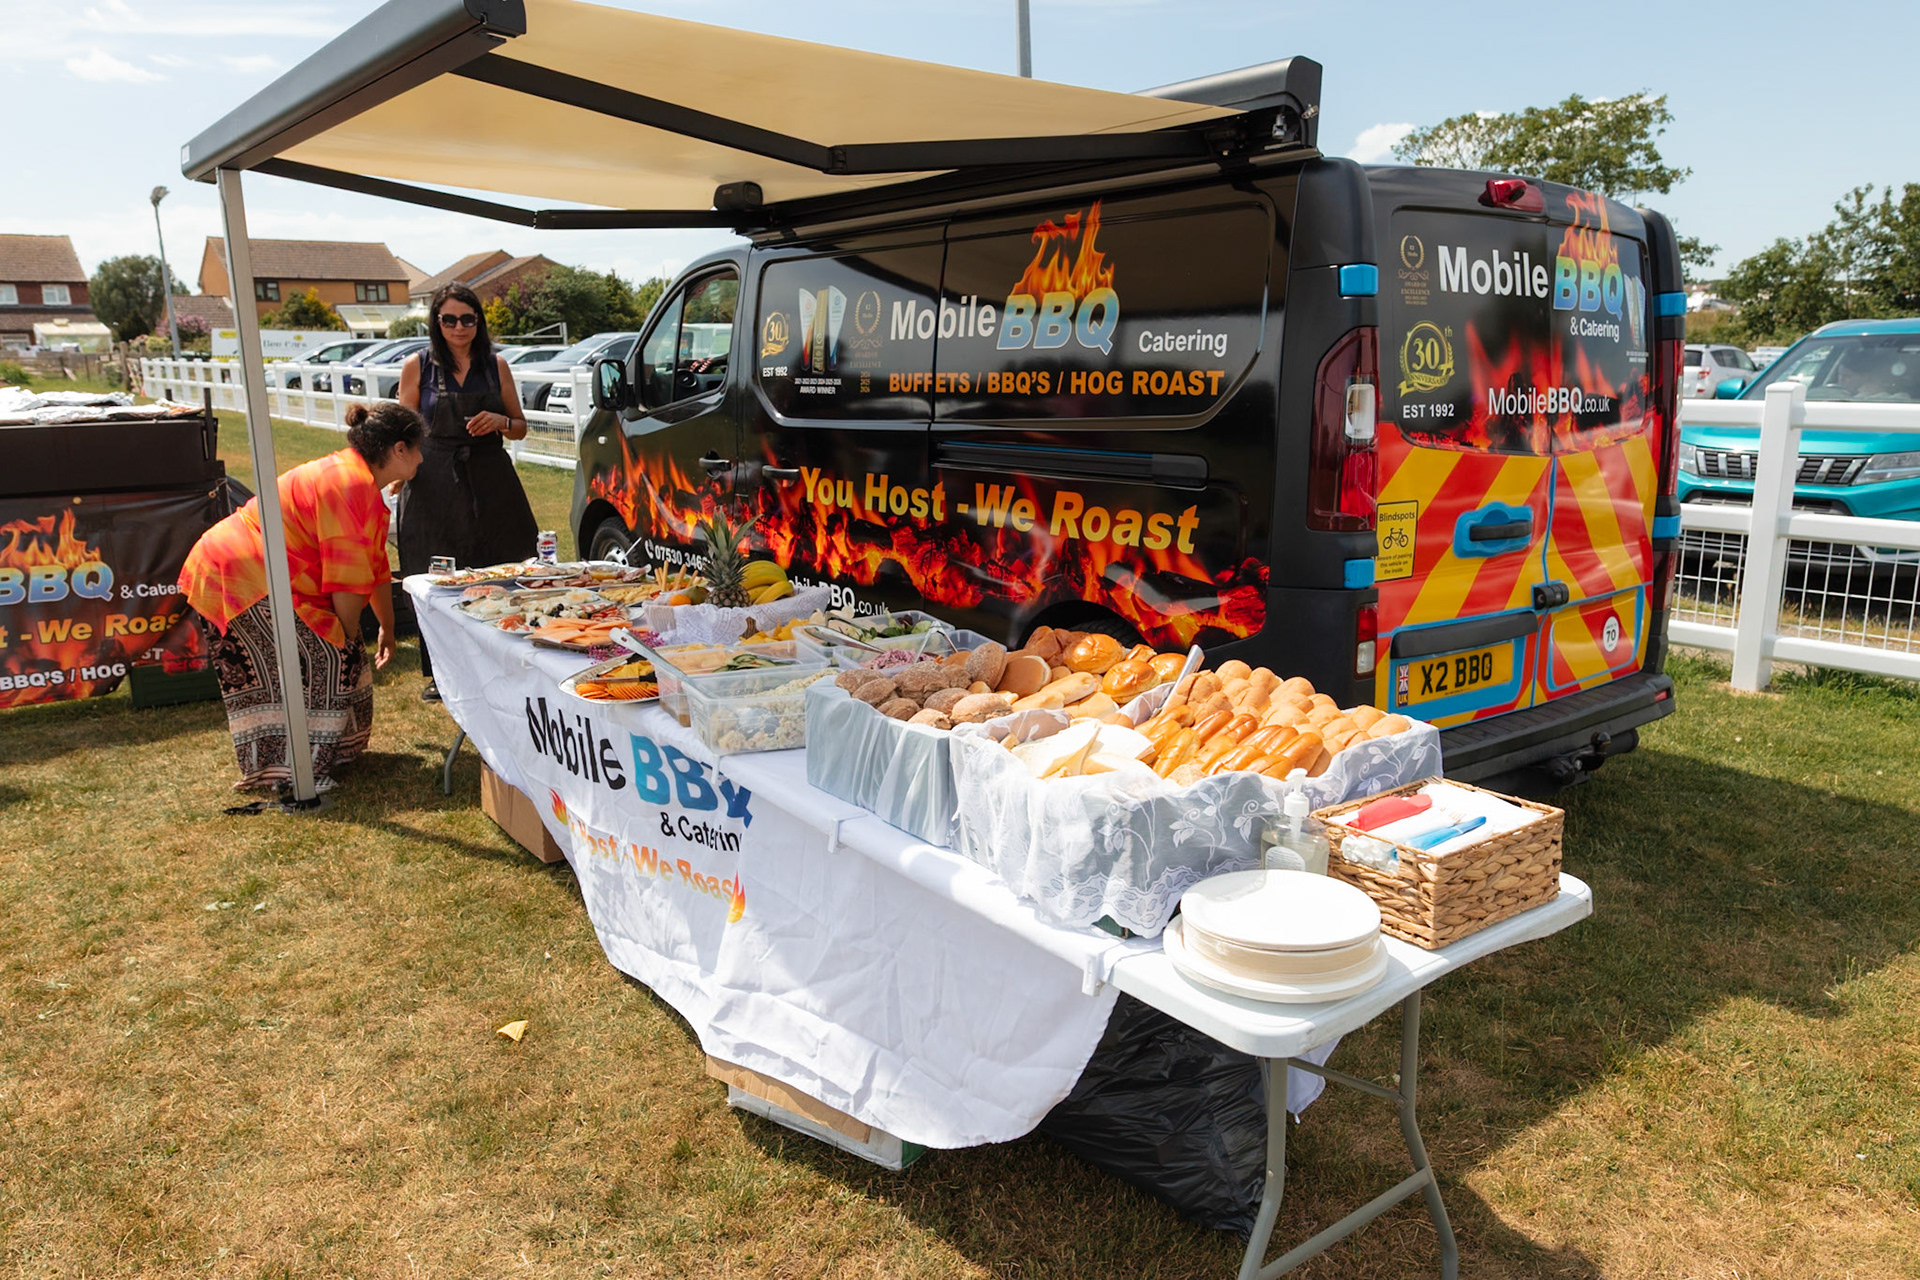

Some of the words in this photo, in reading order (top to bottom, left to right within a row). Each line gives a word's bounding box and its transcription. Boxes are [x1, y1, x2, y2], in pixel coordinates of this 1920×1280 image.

[1438, 245, 1549, 298] Mobile
[1553, 255, 1625, 321] BBQ
[768, 320, 783, 342] 30
[890, 294, 996, 341] Mobile
[996, 287, 1121, 356] BBQ
[1138, 328, 1228, 357] Catering
[1444, 325, 1453, 338] th
[1570, 316, 1580, 337] &
[1580, 318, 1620, 343] Catering
[1412, 337, 1440, 371] 30
[763, 367, 774, 377] EST
[775, 366, 788, 377] 1992
[889, 370, 970, 394] BUFFETS
[987, 370, 1050, 396] BBQ'S
[1070, 370, 1124, 395] HOG
[1131, 370, 1226, 396] ROAST
[1403, 404, 1427, 418] EST
[1429, 403, 1454, 418] 1992
[1488, 386, 1610, 416] MobileBBQ.co.uk
[799, 466, 854, 506] You
[864, 473, 946, 522] Host
[1050, 490, 1201, 555] Roast
[1379, 511, 1415, 522] Blindspots
[655, 545, 683, 566] 07530
[120, 586, 134, 599] &
[105, 610, 182, 637] Roas
[1606, 628, 1616, 643] 70
[0, 669, 64, 691] BBQ'S
[81, 663, 126, 682] HOG
[1421, 661, 1448, 696] X2
[526, 697, 626, 790] Mobile
[660, 812, 676, 837] &
[678, 815, 742, 852] Caterin
[676, 858, 735, 901] Roas
